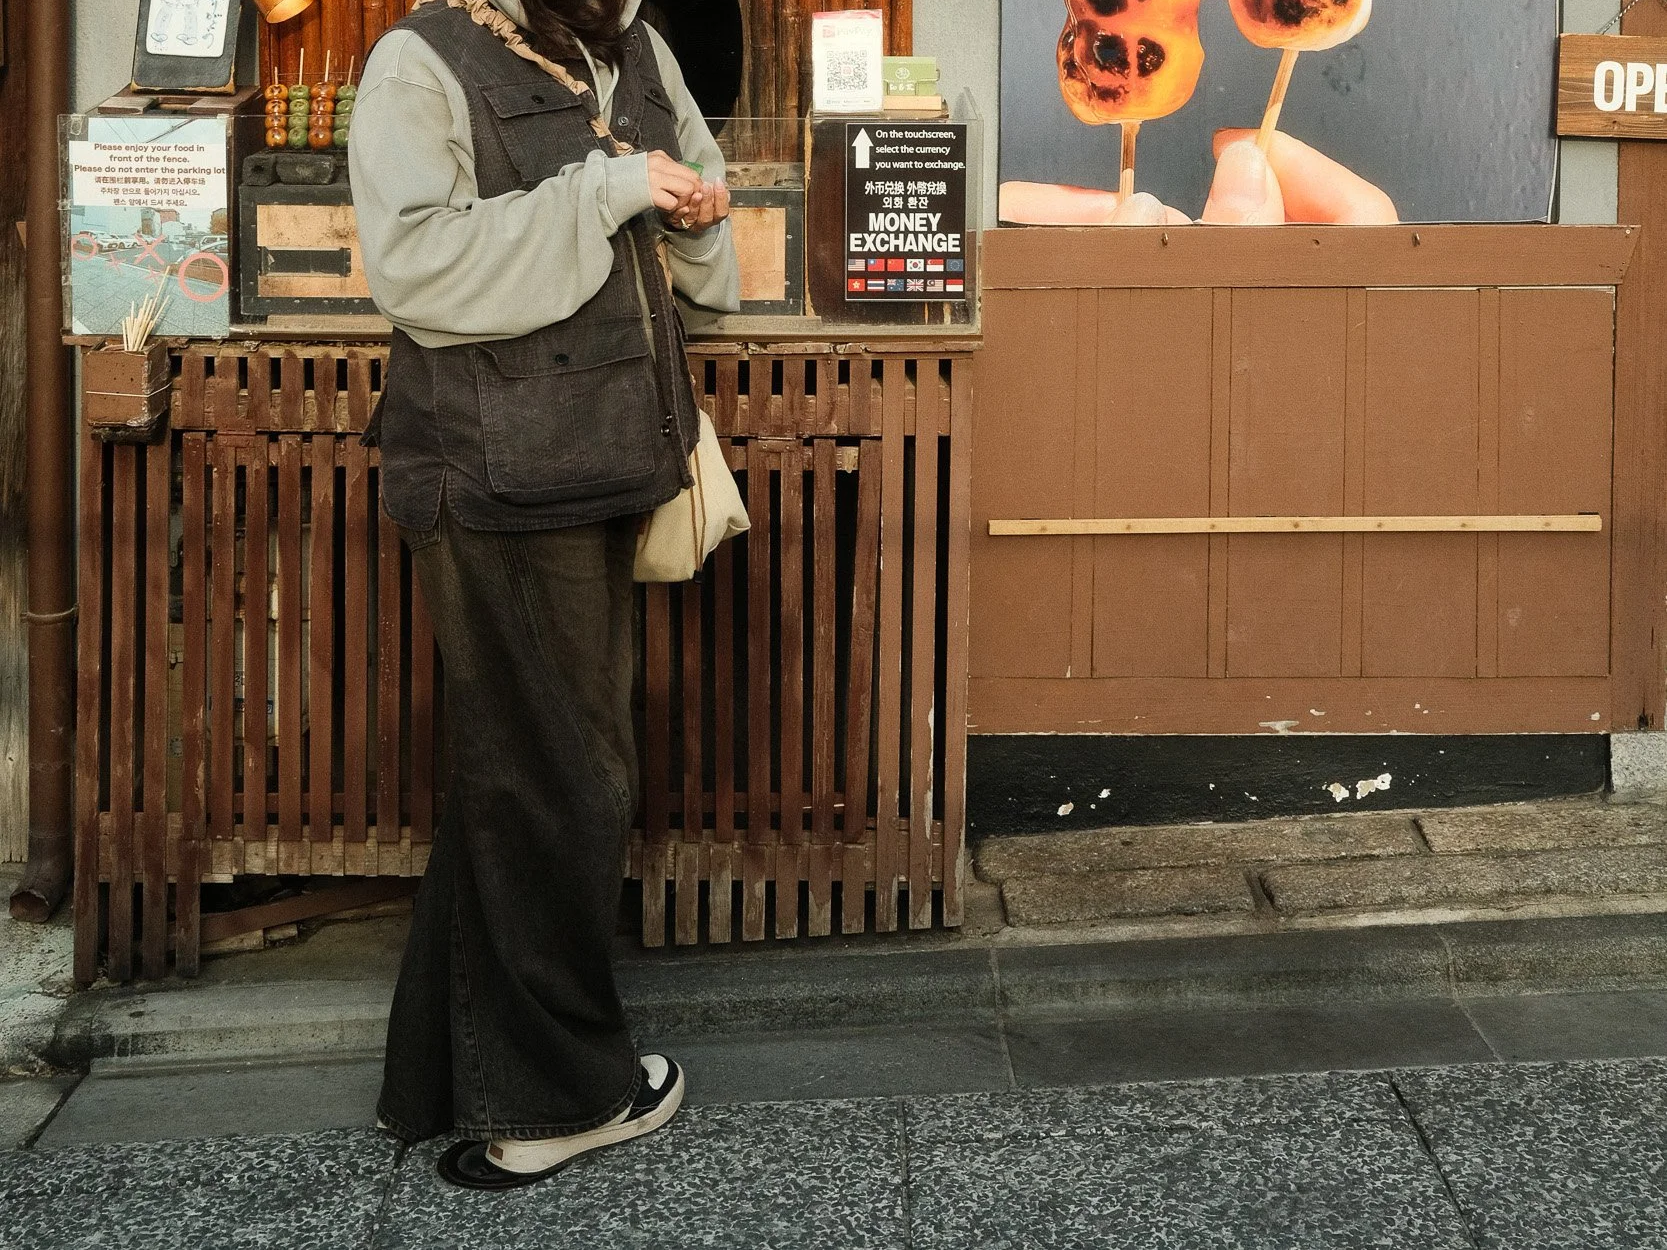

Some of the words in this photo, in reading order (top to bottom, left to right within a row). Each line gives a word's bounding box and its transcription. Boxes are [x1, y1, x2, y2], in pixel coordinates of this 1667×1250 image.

[875, 130, 888, 138] On
[890, 130, 904, 138] the
[904, 130, 956, 140] touchscreen,
[94, 143, 122, 151] Please
[124, 144, 148, 152] enjoy
[174, 144, 194, 152] food
[876, 144, 900, 154] select
[900, 144, 914, 154] the
[916, 146, 951, 156] currency
[109, 154, 132, 162] front
[134, 154, 144, 162] of
[163, 155, 190, 163] fence.
[74, 164, 102, 172] Please
[104, 165, 116, 173] do
[135, 166, 158, 174] enter
[161, 166, 175, 174] the
[177, 167, 211, 175] parking
[875, 161, 891, 170] you
[892, 161, 913, 169] want
[924, 160, 966, 170] exchange.
[100, 187, 120, 195] 주차장
[864, 180, 905, 196] 外币兑换
[882, 196, 904, 210] 외화
[868, 212, 942, 232] MONEY
[849, 233, 961, 252] EXCHANGE
